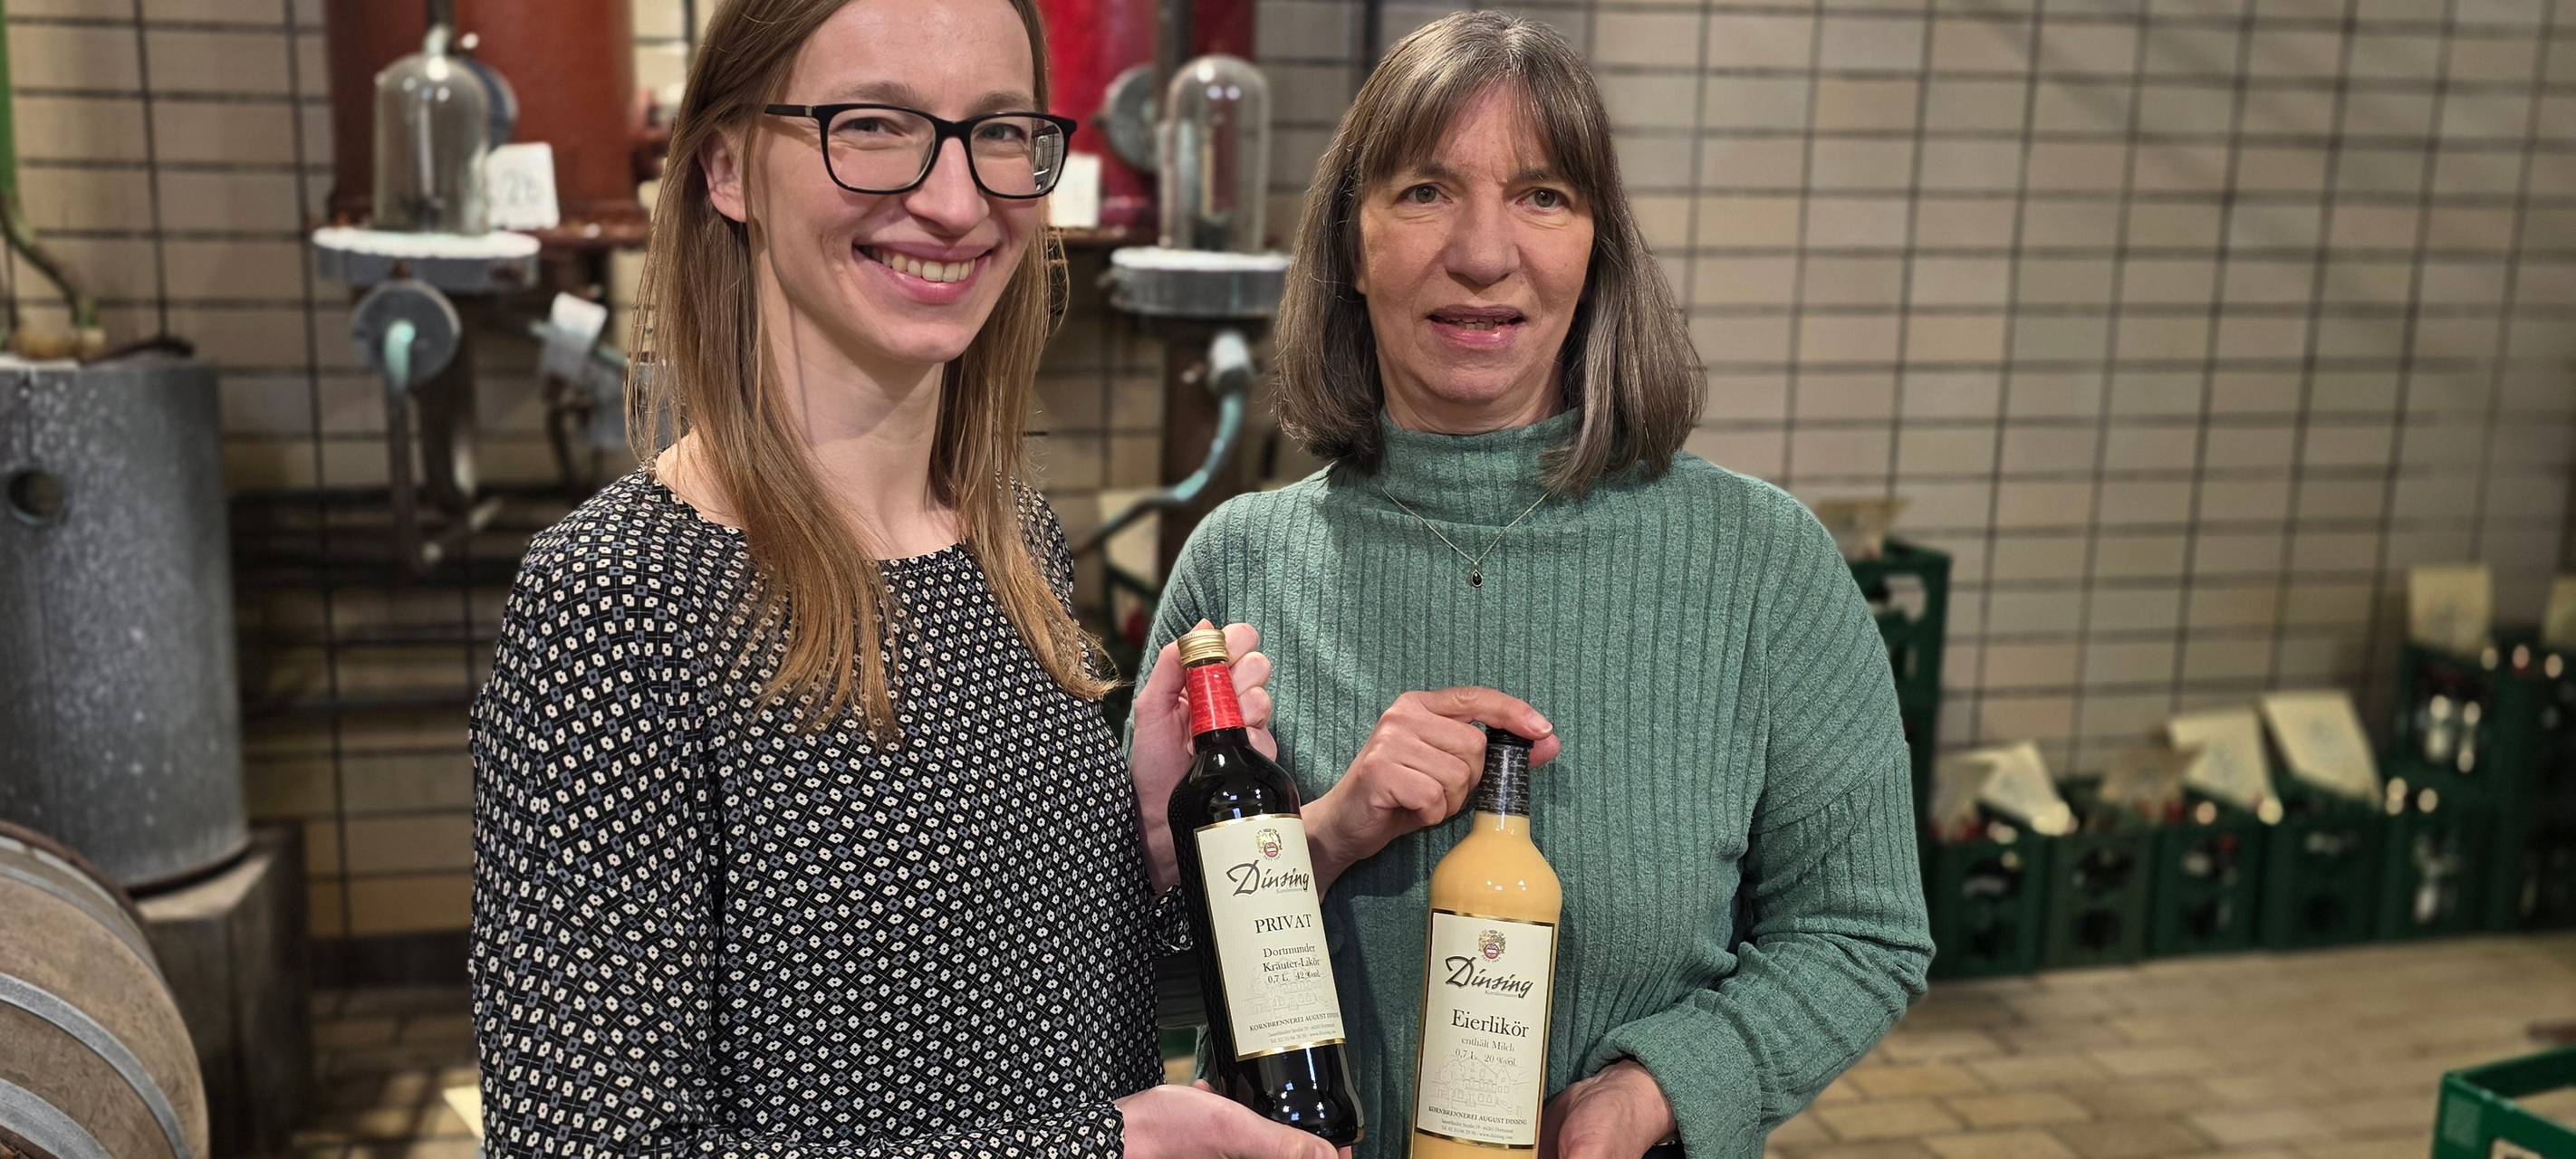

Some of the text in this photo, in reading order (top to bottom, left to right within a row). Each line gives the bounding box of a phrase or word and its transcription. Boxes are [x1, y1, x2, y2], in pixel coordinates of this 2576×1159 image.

[1226, 859, 1310, 896] Dinsing
[1254, 914, 1312, 934] PRIVAT
[1263, 943, 1315, 958] Dortmunder
[1445, 955, 1533, 999] Dinsing
[1249, 1016, 1304, 1031] KORNBRENNEREI
[1451, 1009, 1530, 1038] Eierlikör
[1461, 1037, 1514, 1052] enthält Milch
[1455, 1049, 1467, 1058] 0,7
[1484, 1054, 1495, 1063] 20
[1428, 1106, 1477, 1120] KORNBRENNEREI
[1478, 1114, 1504, 1124] AUGUST
